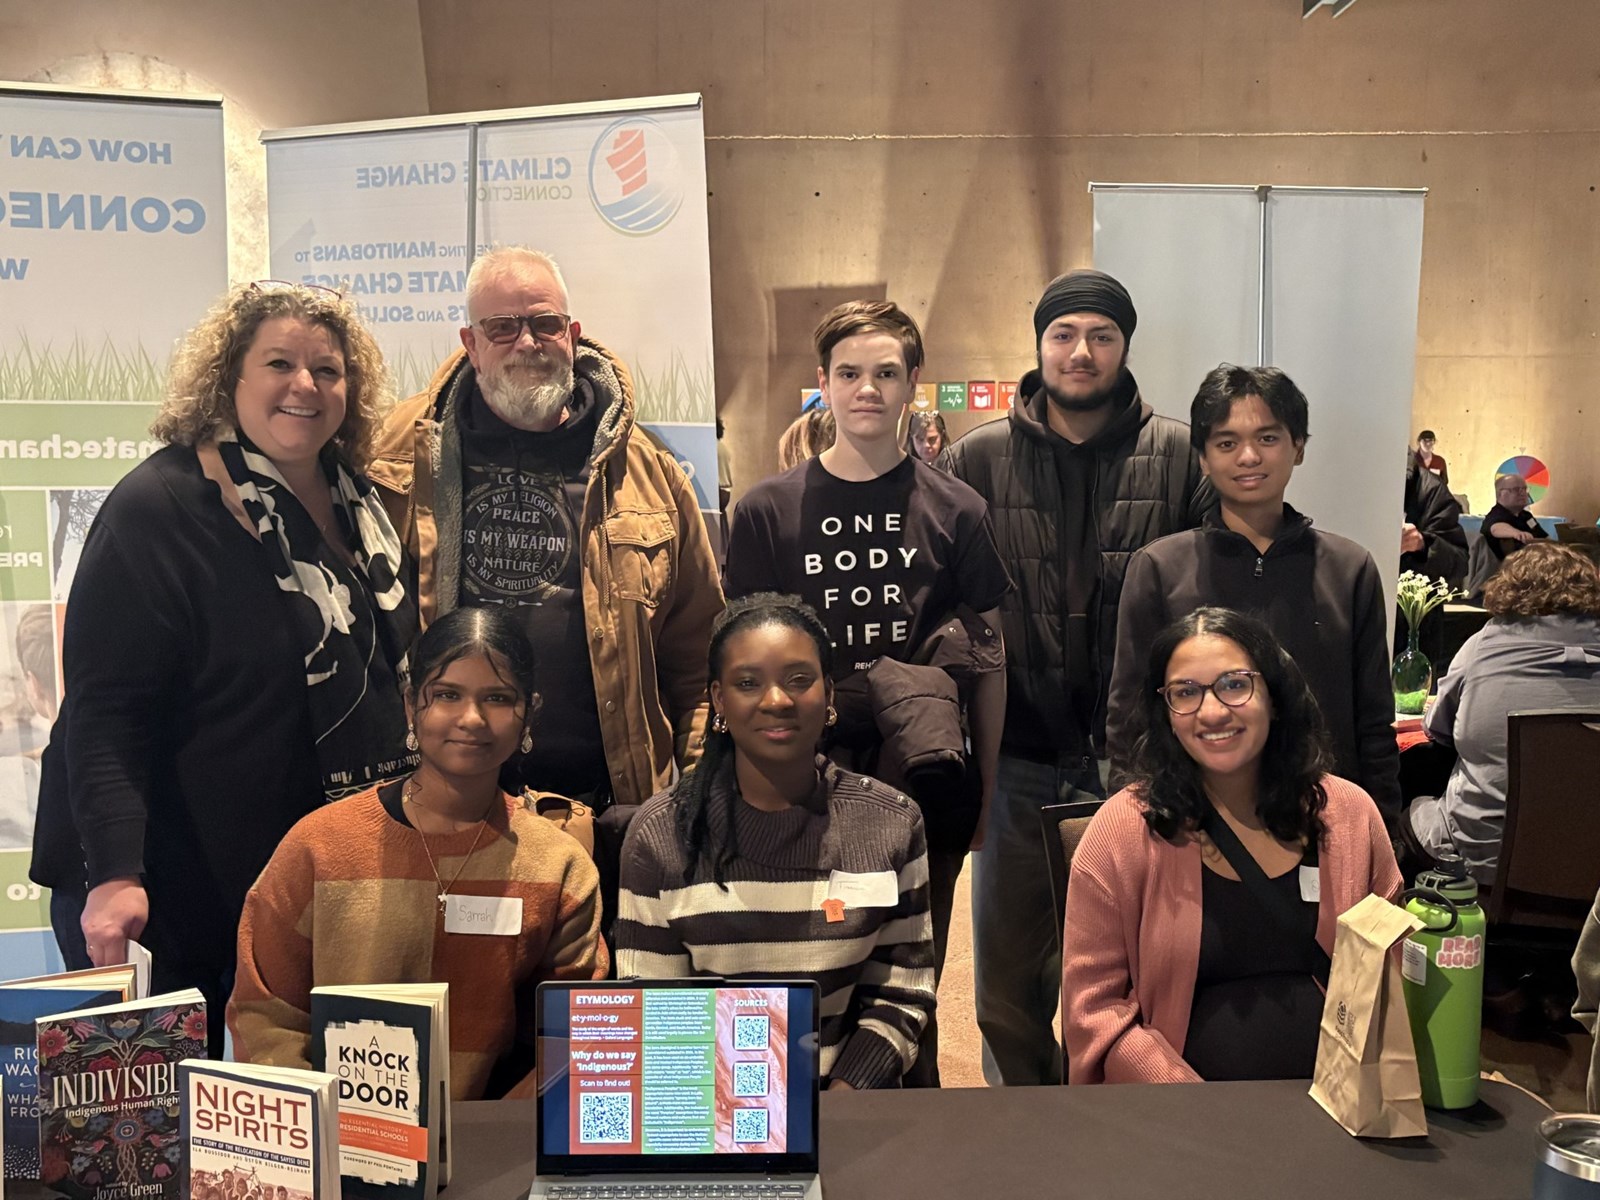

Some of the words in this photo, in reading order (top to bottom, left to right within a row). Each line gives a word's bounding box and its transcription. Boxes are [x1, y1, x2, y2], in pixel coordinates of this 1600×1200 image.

[475, 500, 489, 513] IS
[492, 492, 508, 505] MY
[492, 507, 541, 524] PEACE
[821, 513, 901, 536] ONE
[480, 531, 502, 548] MY
[507, 533, 566, 552] WEAPON
[483, 557, 541, 573] NATURE
[804, 547, 918, 575] BODY
[477, 566, 493, 580] MY
[824, 584, 901, 609] FOR
[831, 620, 908, 648] IFE
[576, 995, 635, 1004] ETYMOLOGY
[734, 999, 768, 1007] SOURCES
[369, 1035, 380, 1050] A
[339, 1045, 409, 1073] KNOCK
[571, 1051, 592, 1061] Why
[593, 1051, 605, 1059] do
[621, 1052, 637, 1061] say
[52, 1061, 180, 1110] INDIVISIBL
[338, 1064, 365, 1080] ON
[375, 1069, 409, 1089] THE
[196, 1081, 307, 1126] NIGHT
[339, 1079, 409, 1110] DOOR
[65, 1104, 119, 1119] Indigenous
[121, 1099, 155, 1111] Human
[195, 1109, 309, 1150] SPIRITS
[340, 1123, 380, 1137] RESIDENTIAL
[379, 1130, 409, 1142] SCHOOLS
[130, 1182, 163, 1196] Green
